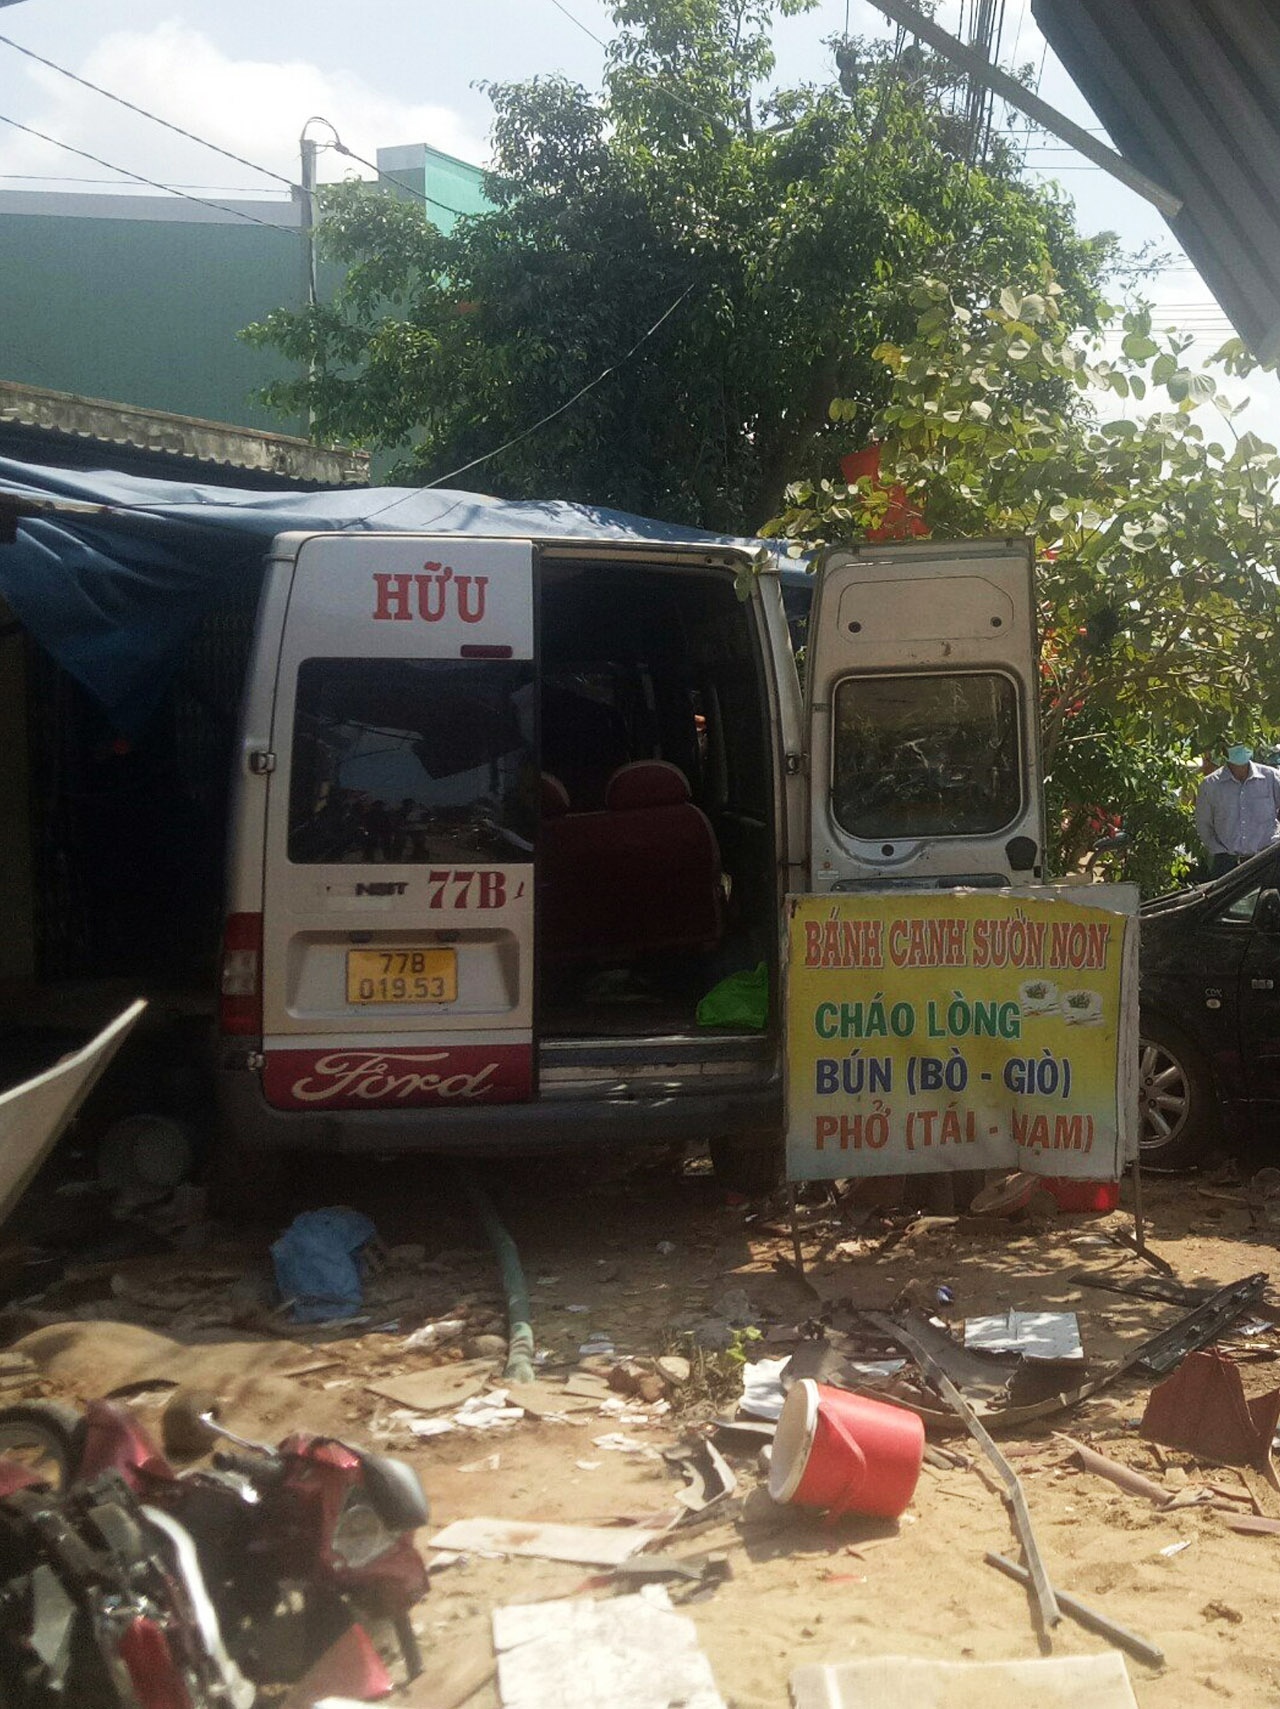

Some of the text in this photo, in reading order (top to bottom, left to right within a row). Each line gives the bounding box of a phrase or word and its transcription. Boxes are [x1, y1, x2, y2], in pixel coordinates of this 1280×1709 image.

[373, 561, 488, 623] HỮU
[804, 906, 1109, 970] BÁNH CANH SƯỜN NON
[359, 977, 446, 998] 019.53
[379, 953, 425, 973] 77B
[814, 990, 1021, 1039] CHÁO LÒNG
[292, 1052, 499, 1101] Ford
[815, 1049, 892, 1095] BÚN
[906, 1047, 968, 1095] (BÒ
[1003, 1048, 1071, 1098] GIÒ)
[815, 1100, 891, 1150] PHỞ
[905, 1101, 975, 1150] (TÁI
